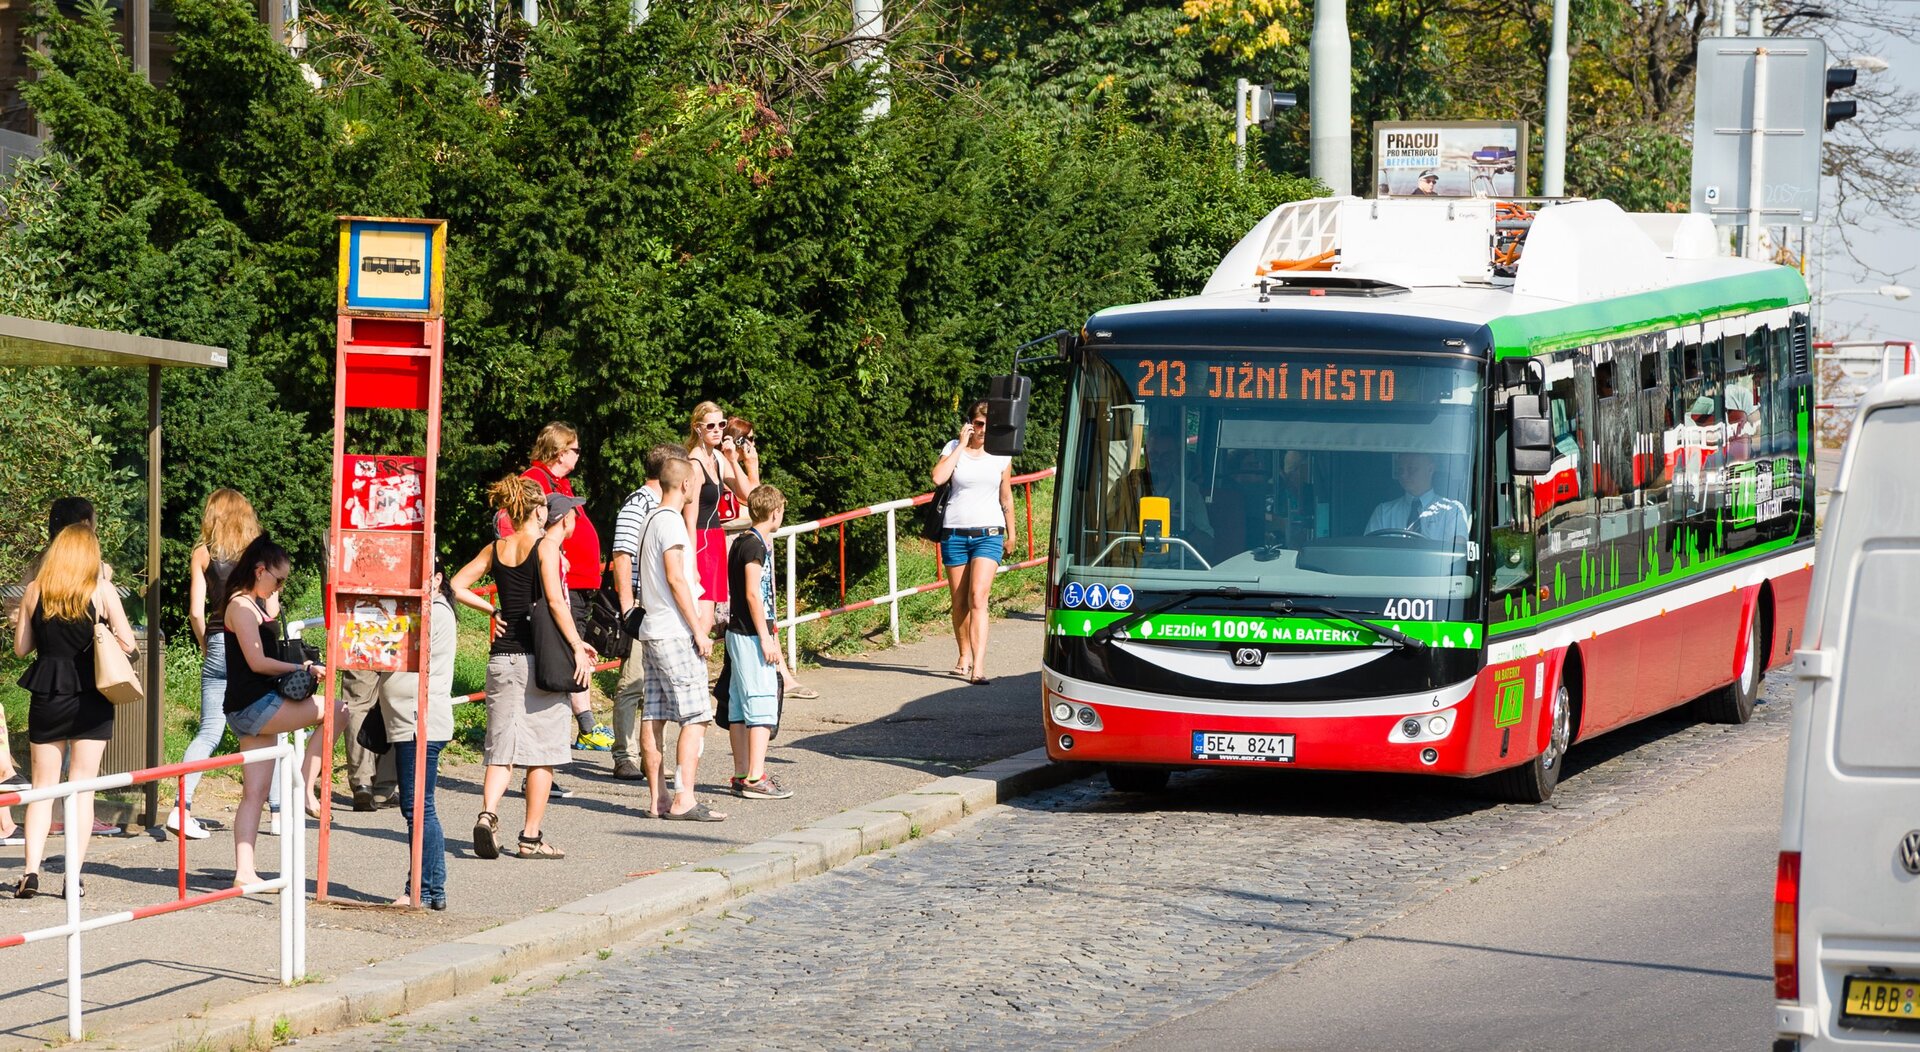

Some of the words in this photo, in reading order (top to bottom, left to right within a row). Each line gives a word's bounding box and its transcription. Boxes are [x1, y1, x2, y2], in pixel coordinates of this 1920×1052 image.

[1386, 133, 1439, 149] PRACUJ
[1386, 149, 1400, 157] PRO
[1401, 148, 1439, 157] METROPOLI
[1138, 360, 1186, 396] 213
[1209, 362, 1288, 399] JIŽNÍ
[1301, 363, 1395, 401] MĚSTO
[1383, 598, 1433, 620] 4001
[1157, 622, 1207, 637] JEZDÍM
[1212, 620, 1268, 640] 100%
[1272, 627, 1292, 639] NA
[1296, 628, 1360, 642] BATERKY
[1057, 680, 1064, 693] 6
[1432, 695, 1440, 708] 6
[1207, 736, 1235, 752] 5E4
[1248, 737, 1285, 754] 8241
[1860, 985, 1900, 1013] ABB
